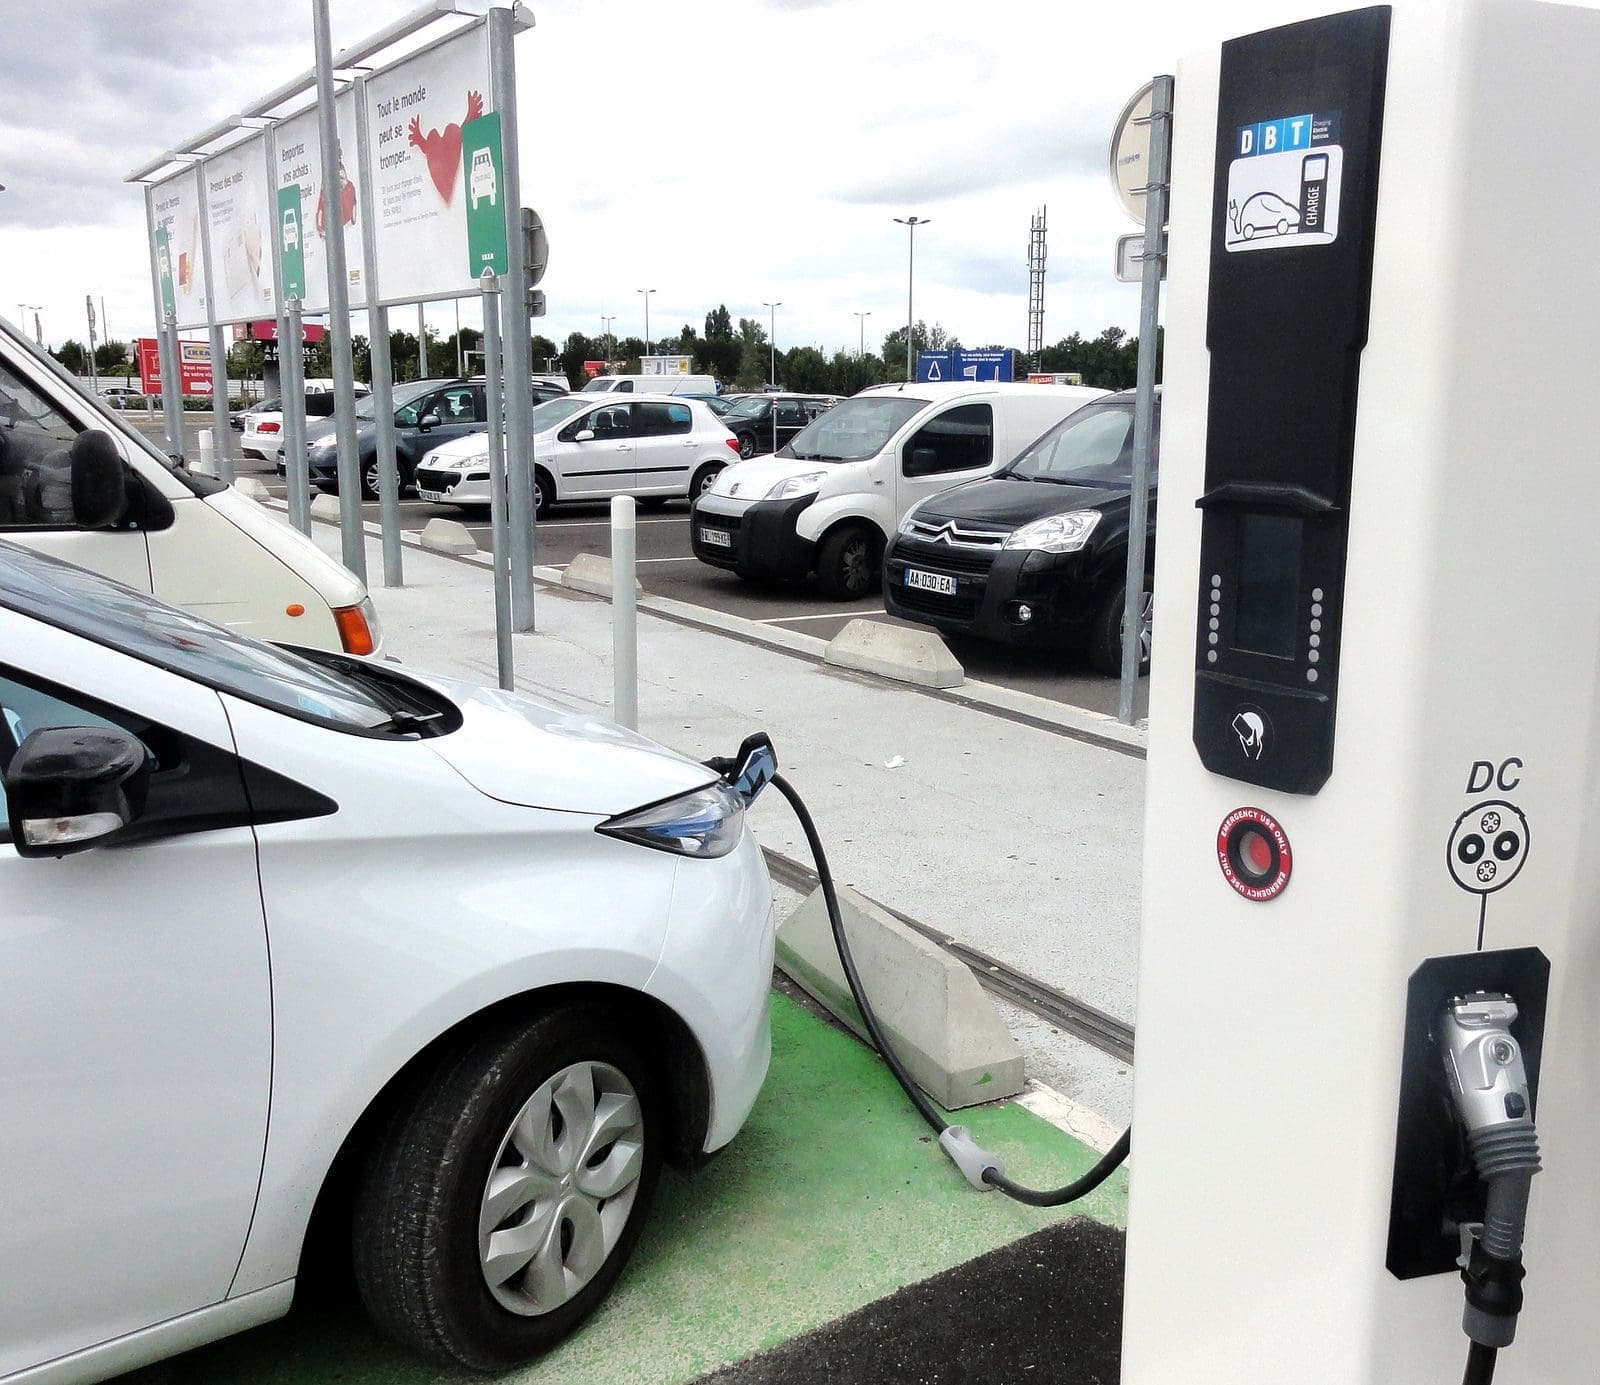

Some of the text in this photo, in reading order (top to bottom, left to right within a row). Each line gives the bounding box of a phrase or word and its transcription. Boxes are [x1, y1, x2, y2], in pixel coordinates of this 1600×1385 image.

[377, 85, 426, 118] Tout le monde
[379, 124, 403, 148] peut se
[1305, 186, 1320, 225] CHARGE
[1466, 757, 1524, 794] DC
[1220, 810, 1288, 855] EMERGENCY USE ONLY
[1219, 851, 1286, 898] EMERGENCY USE ONLY
